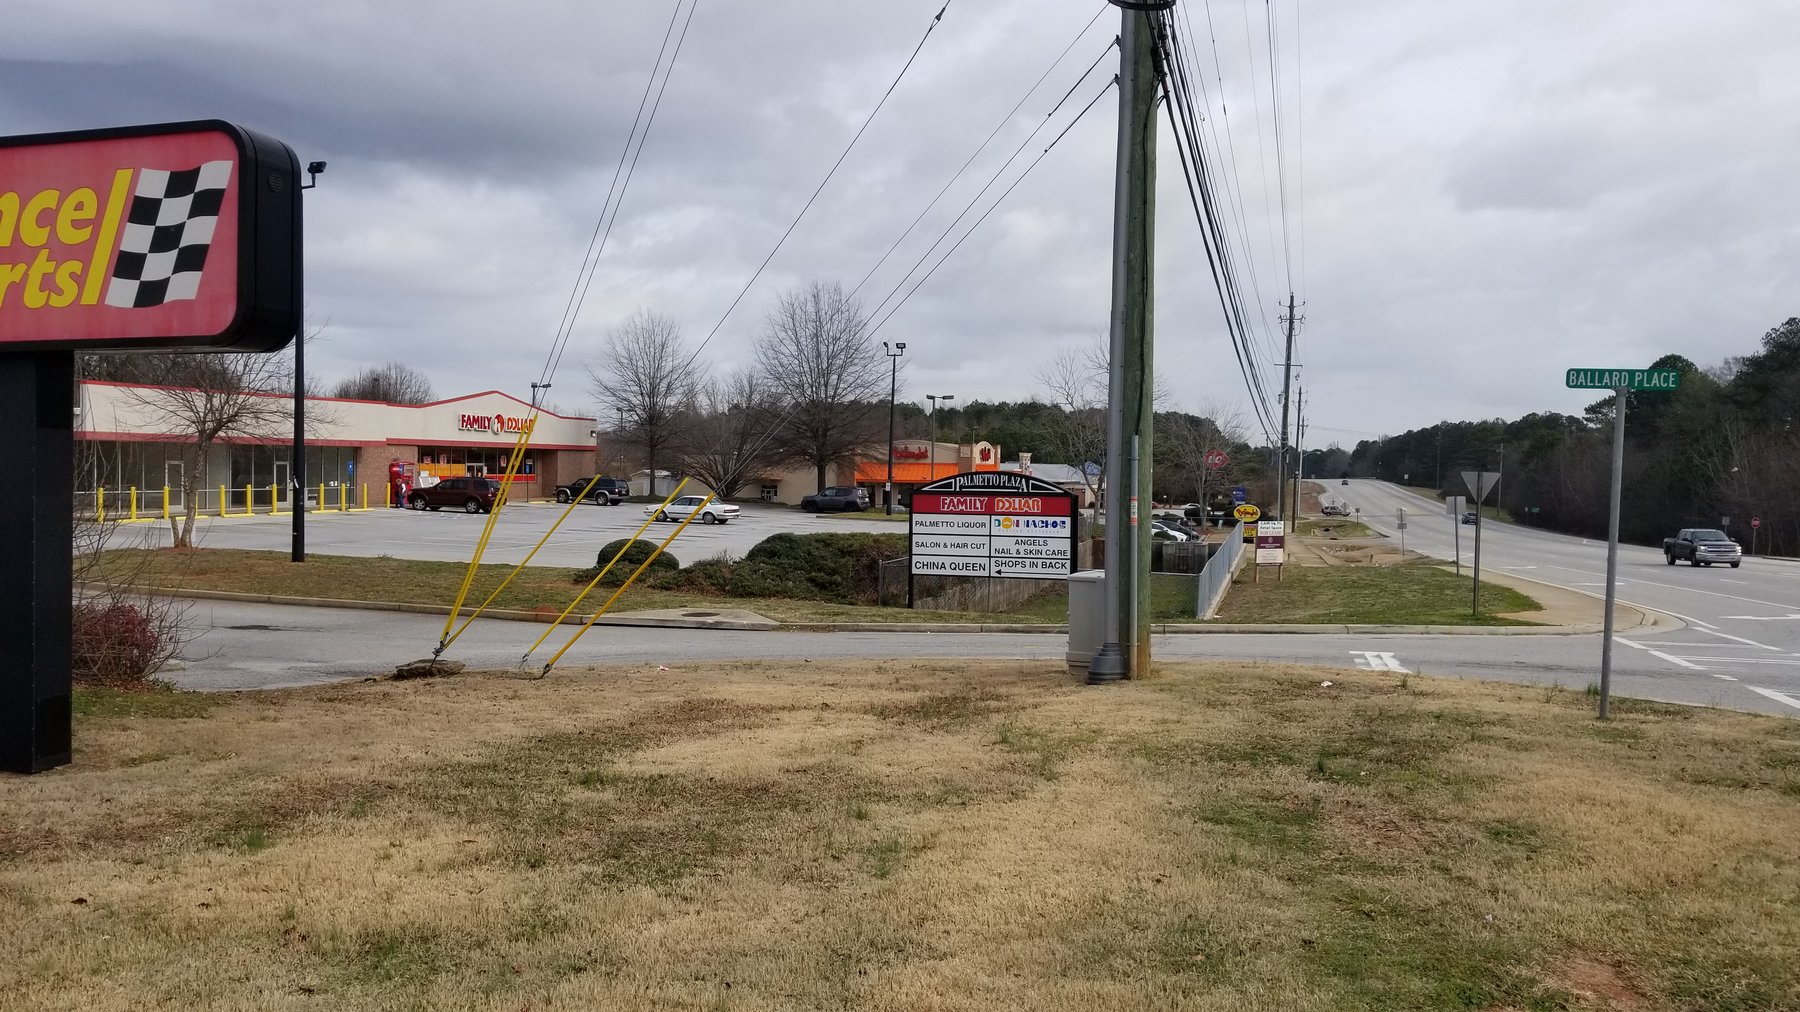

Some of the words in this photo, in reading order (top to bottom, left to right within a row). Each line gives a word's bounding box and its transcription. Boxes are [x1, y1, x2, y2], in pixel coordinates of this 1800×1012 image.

[1569, 371, 1629, 387] BALLARD
[1634, 372, 1677, 387] PLACE
[460, 413, 492, 431] FAMILY
[955, 474, 999, 492] PALMETTO
[1000, 475, 1028, 492] PLAZA
[940, 496, 988, 512] FAMILY
[994, 497, 1042, 513] DOLLAR
[914, 520, 955, 528] PALMETTO
[957, 521, 987, 529] LIQUOR
[994, 517, 1020, 529] DON
[970, 542, 986, 550] CUT
[1014, 539, 1048, 547] ANGELS
[1015, 548, 1021, 556] &
[1023, 548, 1043, 556] SKIN
[1045, 549, 1068, 557] CARE
[914, 561, 947, 570] CHINA
[949, 561, 986, 572] QUEEN
[994, 559, 1027, 569] SHOPS
[1029, 560, 1039, 568] IN
[1041, 561, 1068, 570] BACK
